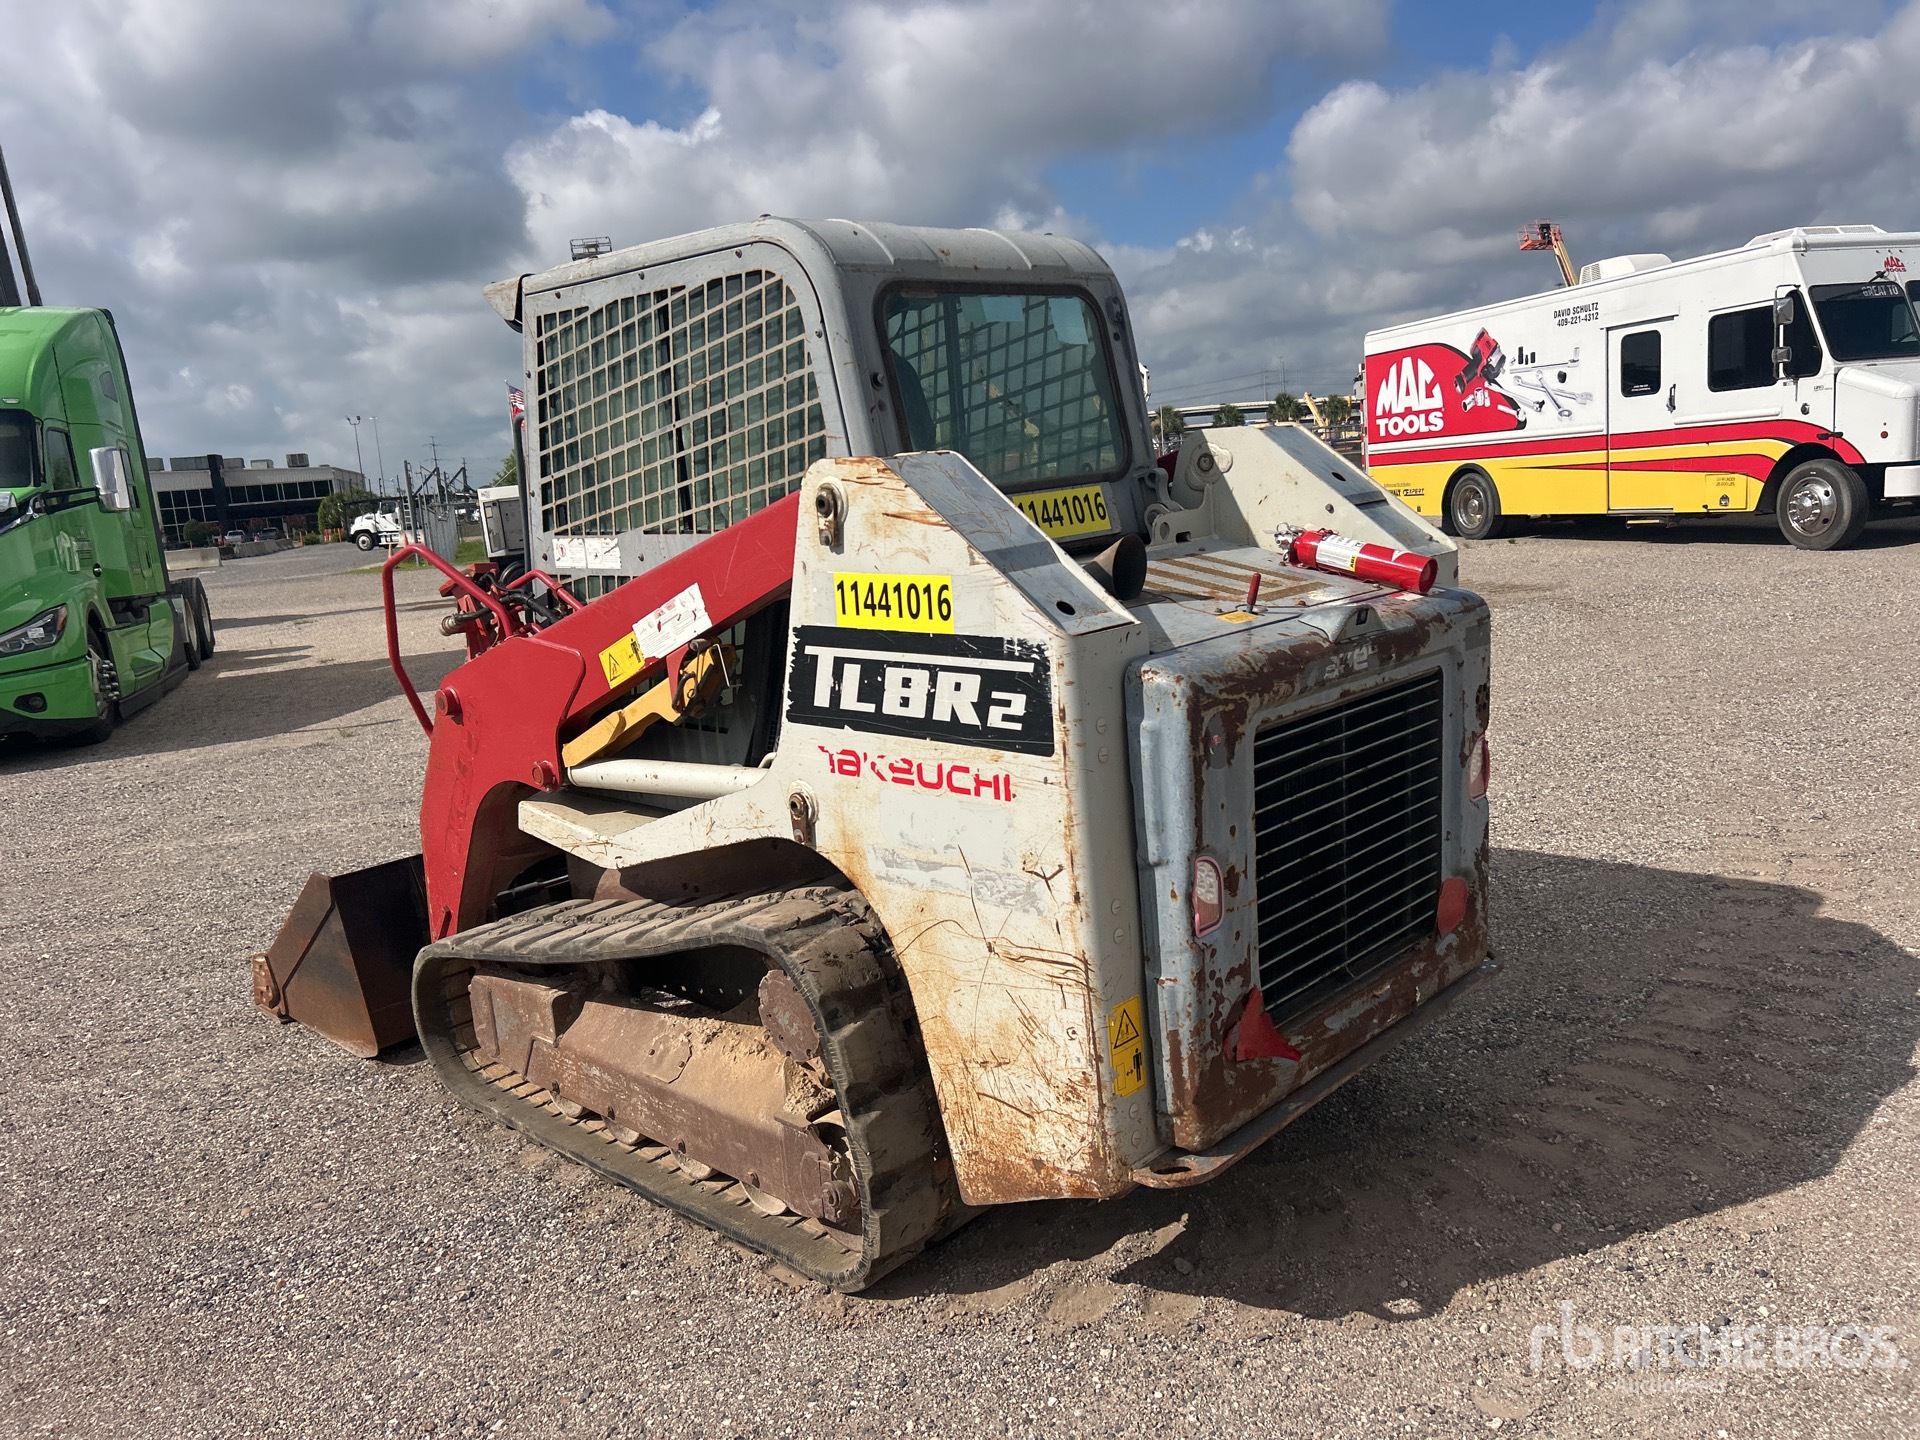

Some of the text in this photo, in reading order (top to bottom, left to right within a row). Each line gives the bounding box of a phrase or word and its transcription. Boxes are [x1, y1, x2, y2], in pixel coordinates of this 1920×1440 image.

[1553, 302, 1599, 318] DAVID SCHULTZ
[1557, 312, 1598, 326] 409-221-4312
[1375, 356, 1443, 416] MAC
[1375, 411, 1445, 437] TOOLS
[836, 580, 952, 622] 11441016
